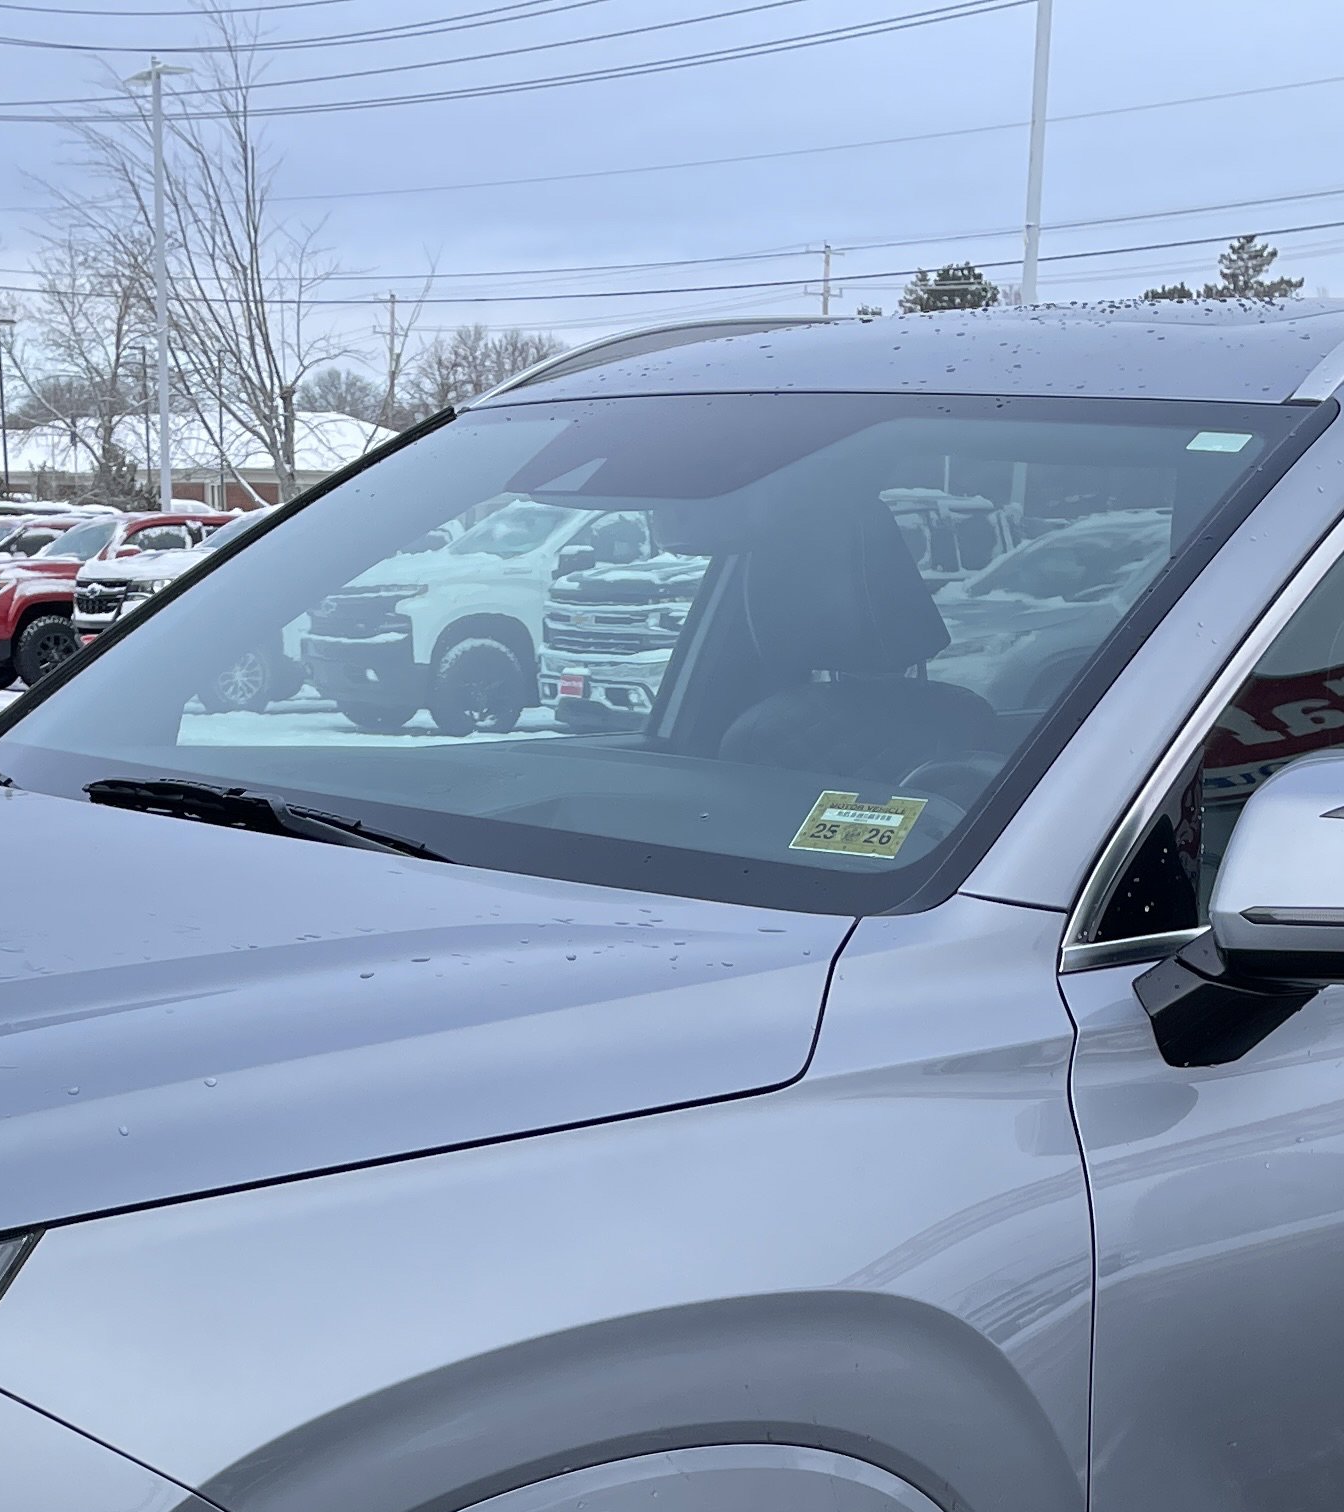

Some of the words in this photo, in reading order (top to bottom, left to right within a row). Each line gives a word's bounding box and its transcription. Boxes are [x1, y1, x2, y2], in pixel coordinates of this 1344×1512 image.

[830, 802, 865, 811] MOTOR
[810, 823, 841, 840] 25
[863, 828, 895, 846] 26
